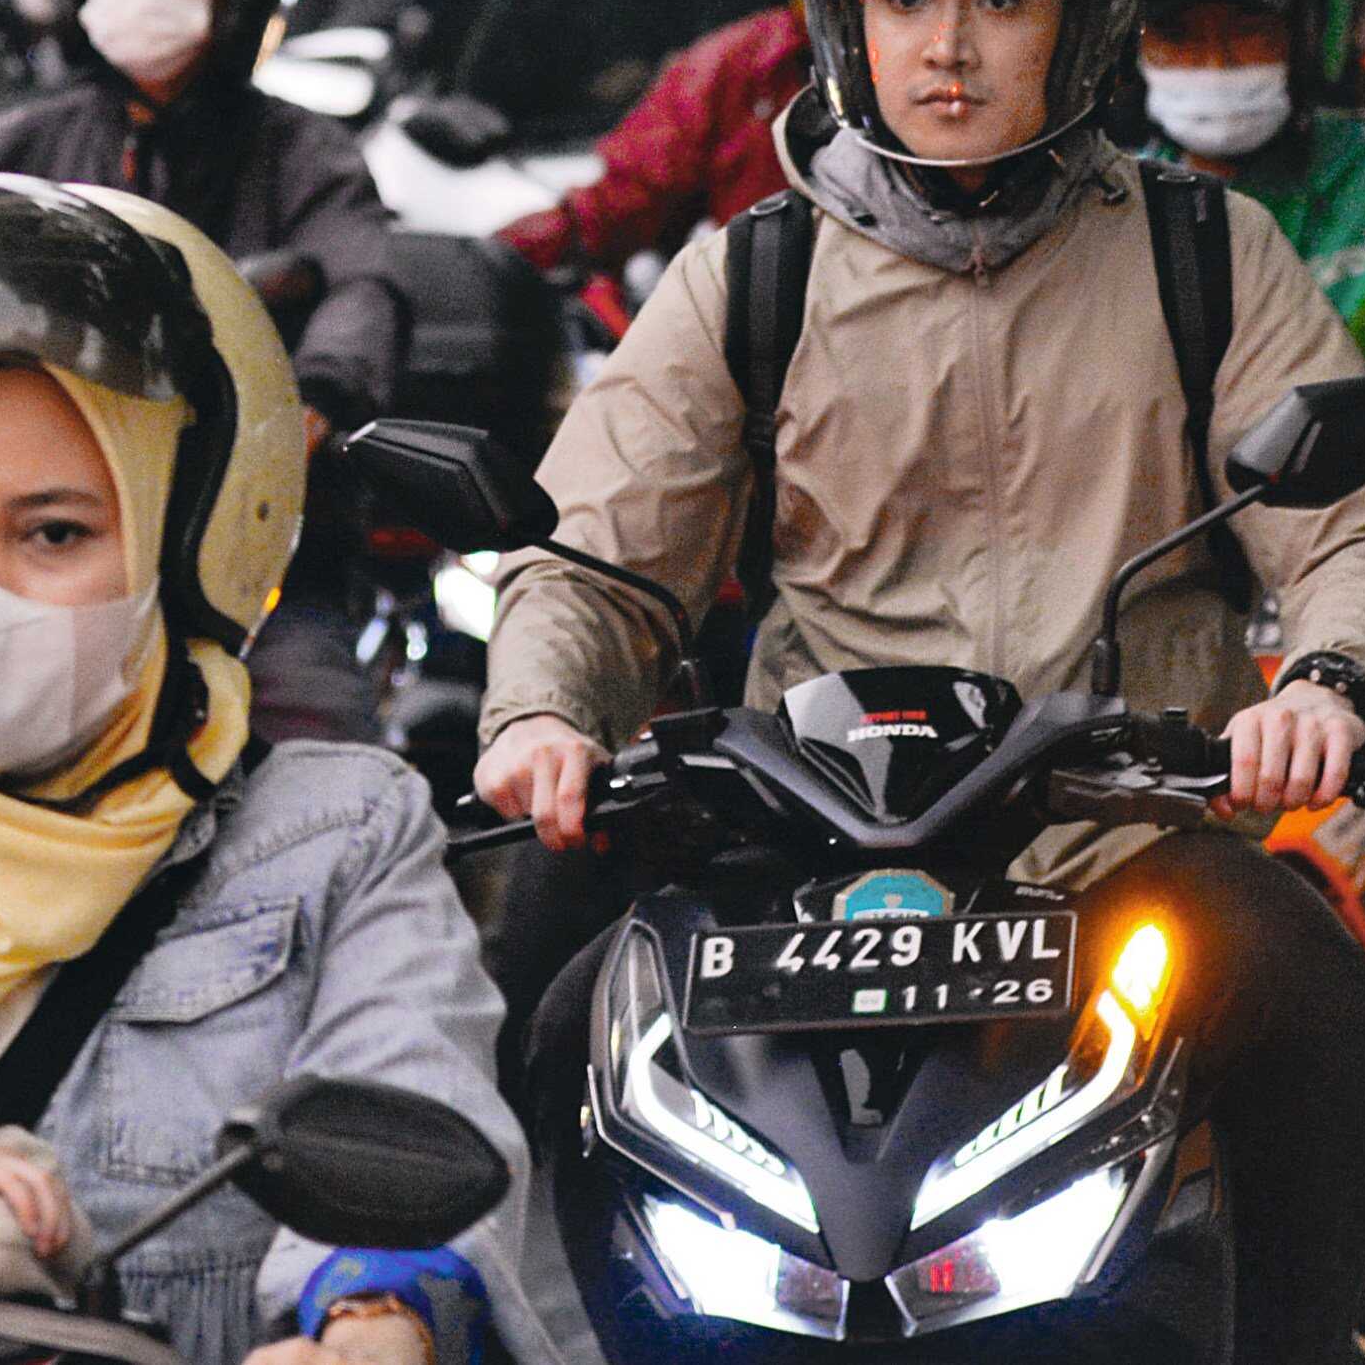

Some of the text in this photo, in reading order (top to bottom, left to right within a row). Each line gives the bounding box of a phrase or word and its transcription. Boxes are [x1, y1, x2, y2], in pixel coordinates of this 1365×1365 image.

[846, 724, 939, 742] HONDA
[700, 918, 1062, 979] B 4429 KVL
